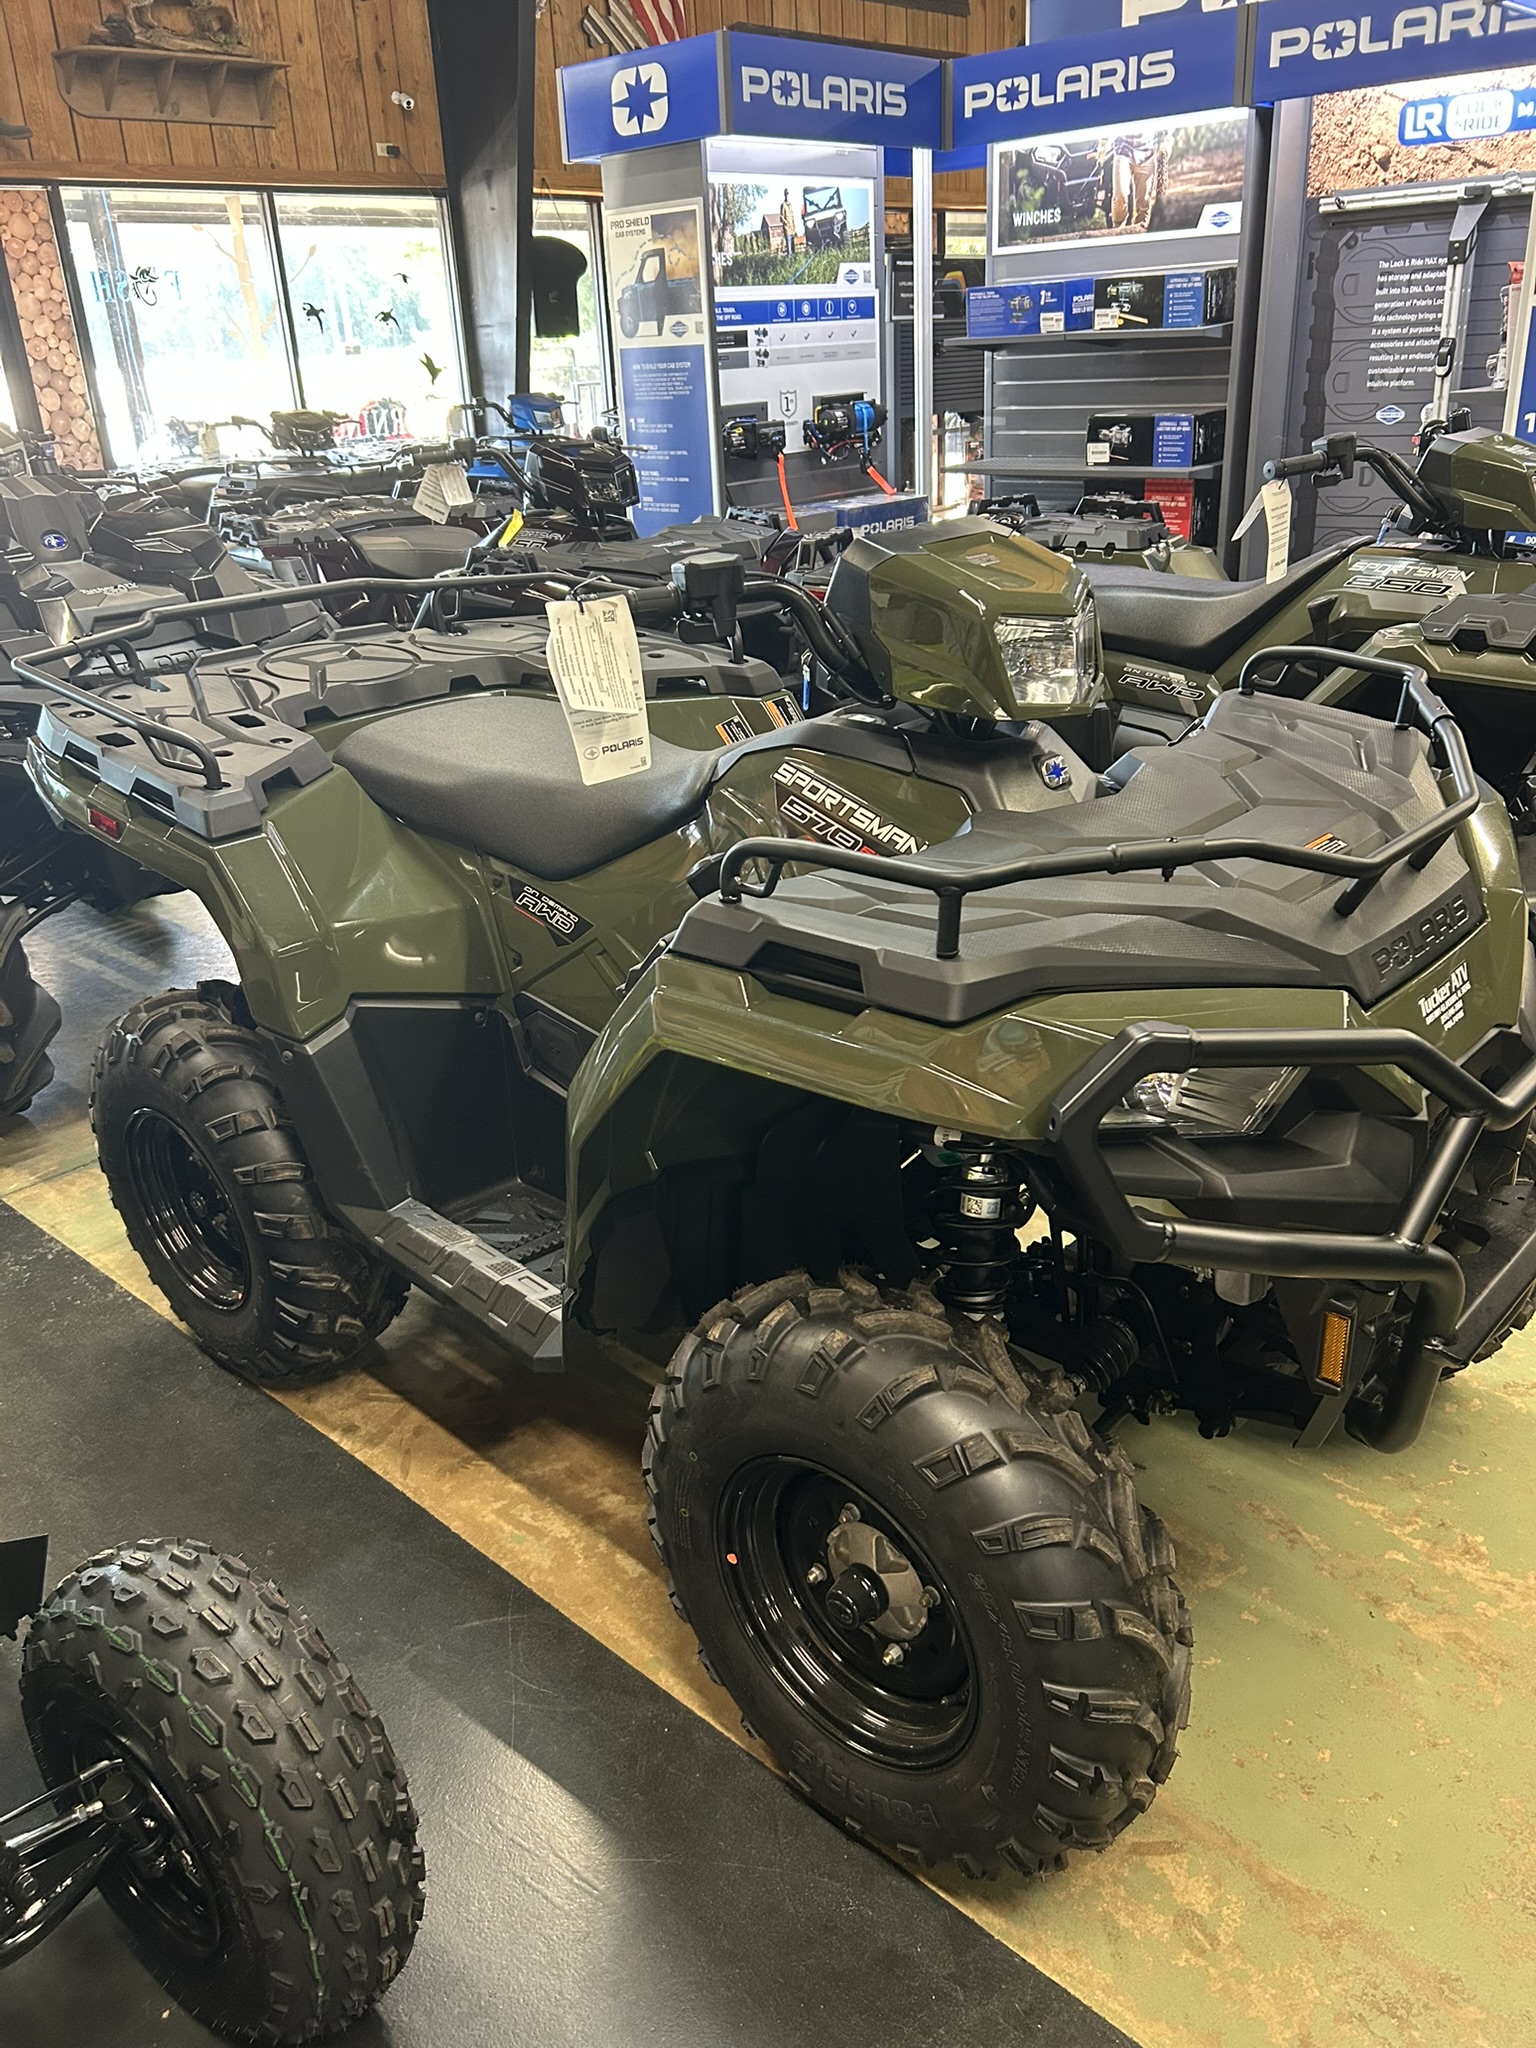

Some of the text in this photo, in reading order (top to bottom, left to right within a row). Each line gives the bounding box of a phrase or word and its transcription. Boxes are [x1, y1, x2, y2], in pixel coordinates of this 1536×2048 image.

[740, 65, 907, 118] POLARIS
[964, 49, 1176, 119] POLARIS
[1404, 102, 1444, 141] LR
[1463, 115, 1503, 132] RIDE
[610, 216, 649, 230] PRO SHIELD
[1012, 206, 1062, 228] WINCHES
[625, 228, 646, 237] SYSTEMS
[1379, 260, 1389, 269] The
[1390, 259, 1404, 268] Lock
[1411, 257, 1424, 266] Ride
[1425, 257, 1438, 265] MAX
[1377, 274, 1388, 282] has
[1388, 273, 1410, 282] storage
[1411, 272, 1422, 280] and
[1376, 288, 1389, 296] built
[1425, 285, 1435, 293] Our
[1374, 298, 1445, 310] generation of Polaris Loc
[1373, 314, 1386, 322] Ride
[1387, 312, 1418, 322] technology
[1418, 312, 1437, 320] brings
[1382, 328, 1402, 337] system
[1403, 326, 1409, 334] of
[1370, 340, 1404, 349] accessories
[1405, 339, 1416, 347] and
[1369, 354, 1394, 363] resulting
[1409, 352, 1436, 360] endlessly
[1368, 366, 1405, 375] customizable
[1390, 379, 1416, 388] platform.
[861, 516, 915, 536] POLARIS
[1348, 561, 1476, 582] SPORTSMAN
[1343, 575, 1455, 597] 850
[1123, 667, 1197, 687] ON DEMAND
[1118, 674, 1206, 701] AWD
[602, 737, 644, 755] POLARIS
[773, 762, 930, 856] SPORTSMAN
[780, 795, 864, 852] 570
[515, 892, 575, 934] AWD
[523, 886, 579, 923] ON DEMAND
[1371, 894, 1470, 984] POLARIS
[1418, 980, 1451, 1018] Tucker
[1450, 961, 1469, 988] ATV
